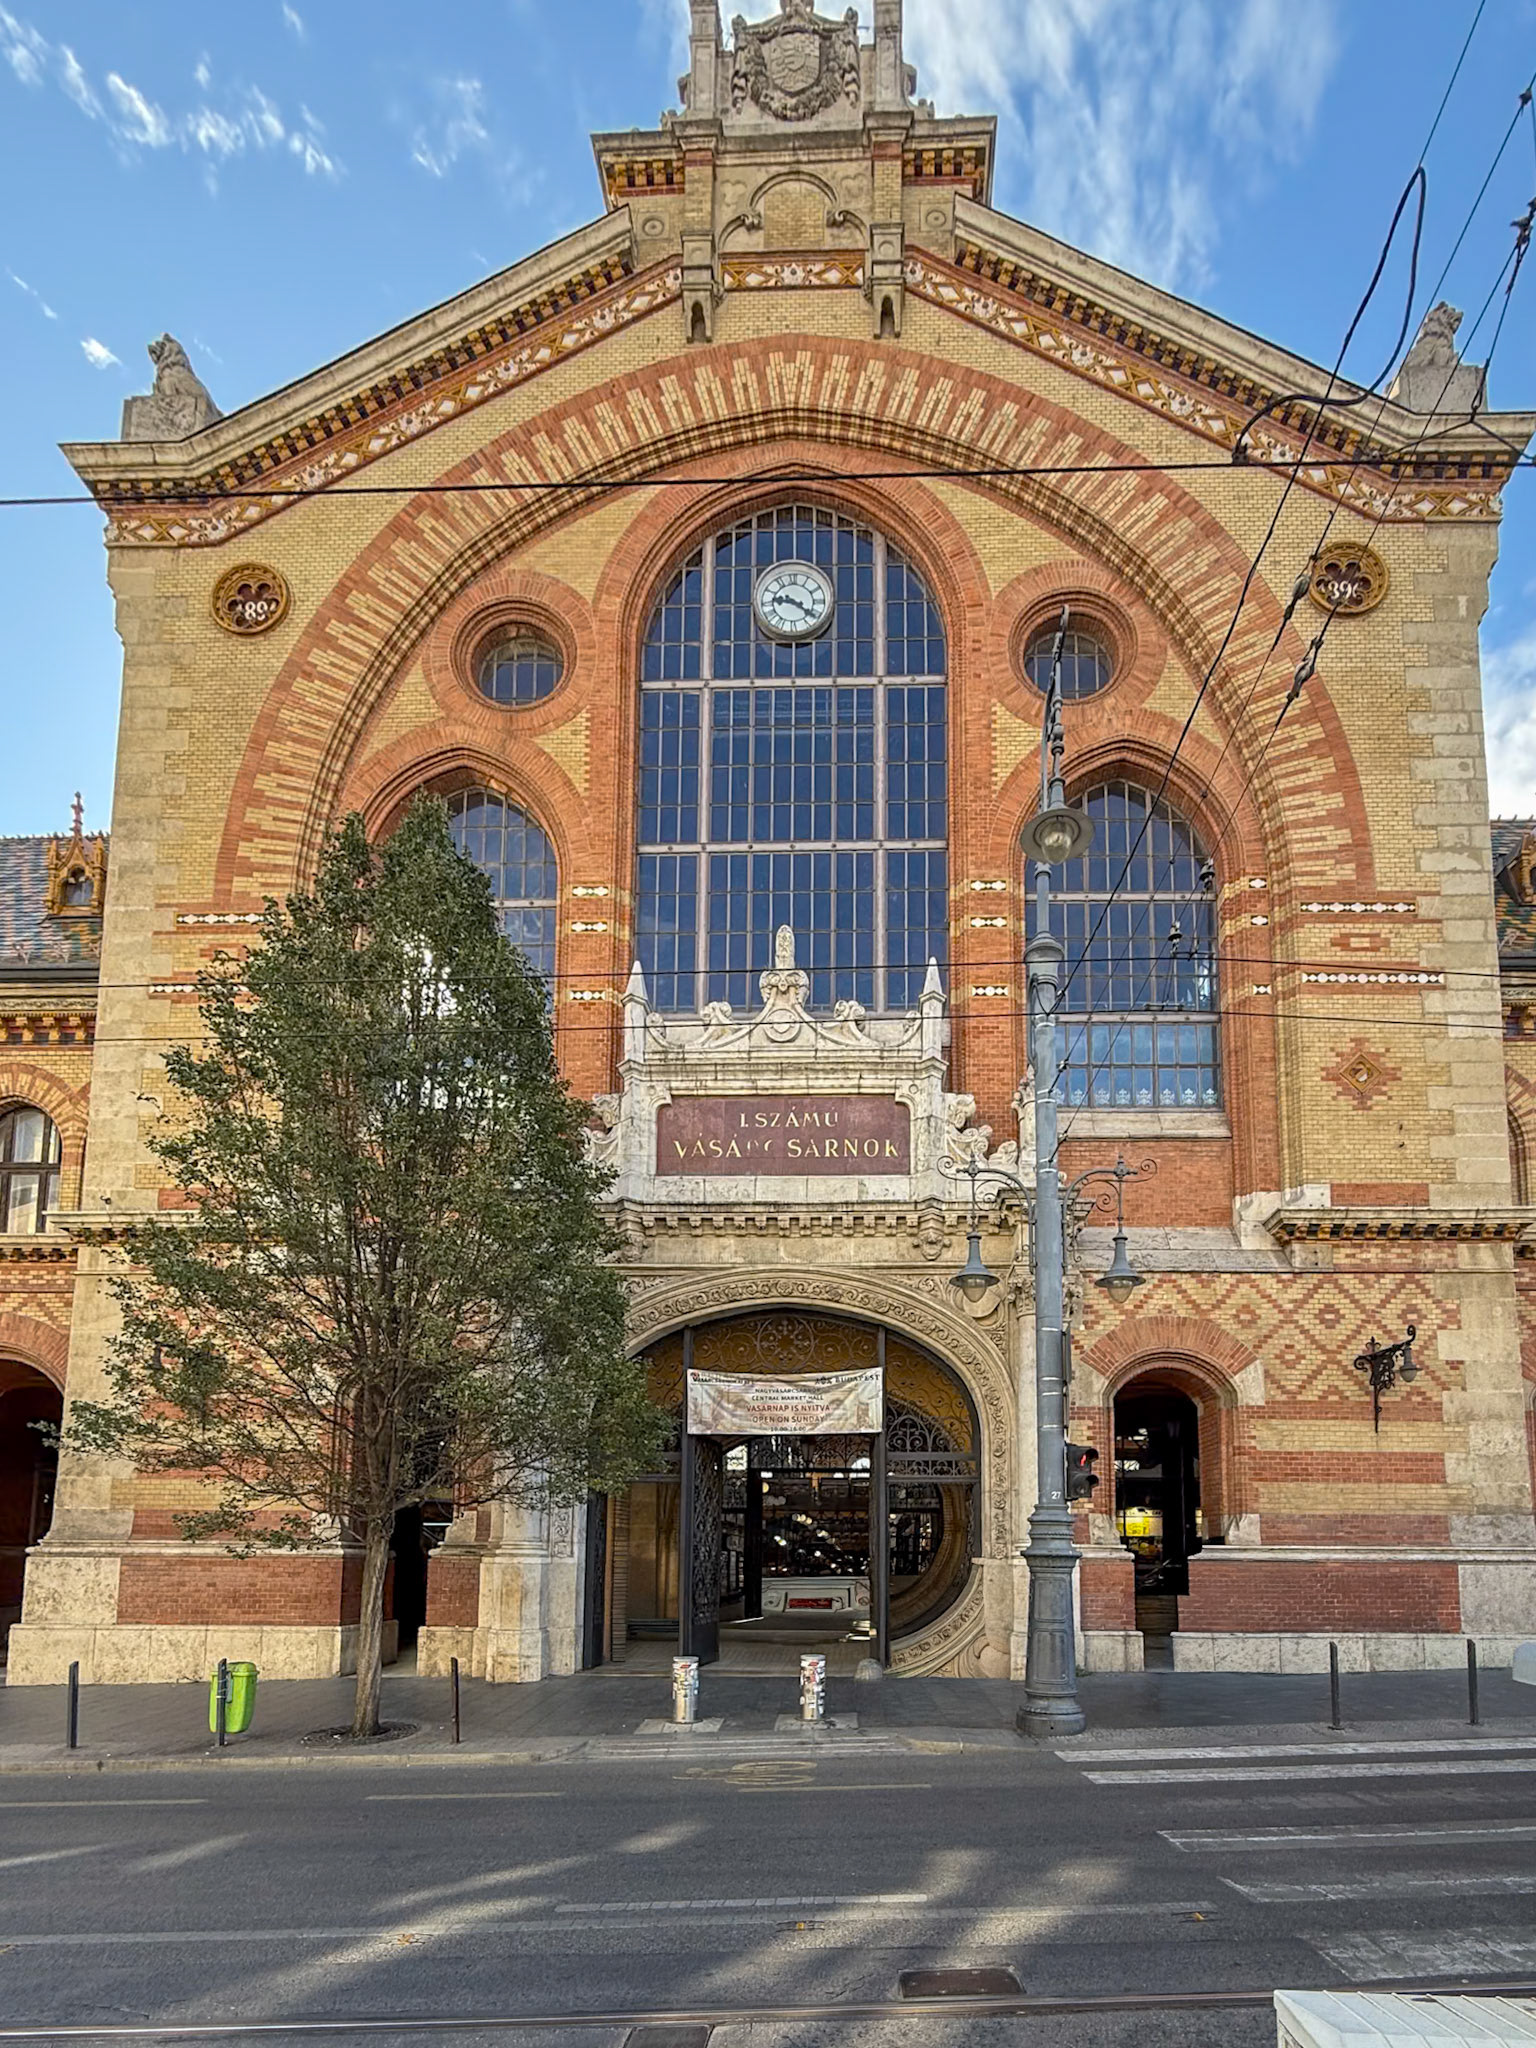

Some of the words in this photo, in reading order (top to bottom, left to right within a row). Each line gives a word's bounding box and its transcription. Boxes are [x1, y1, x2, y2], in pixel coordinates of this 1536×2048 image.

[801, 1404, 830, 1412] NYITVA
[791, 1415, 825, 1423] SUNDAY
[1051, 1490, 1061, 1499] 27
